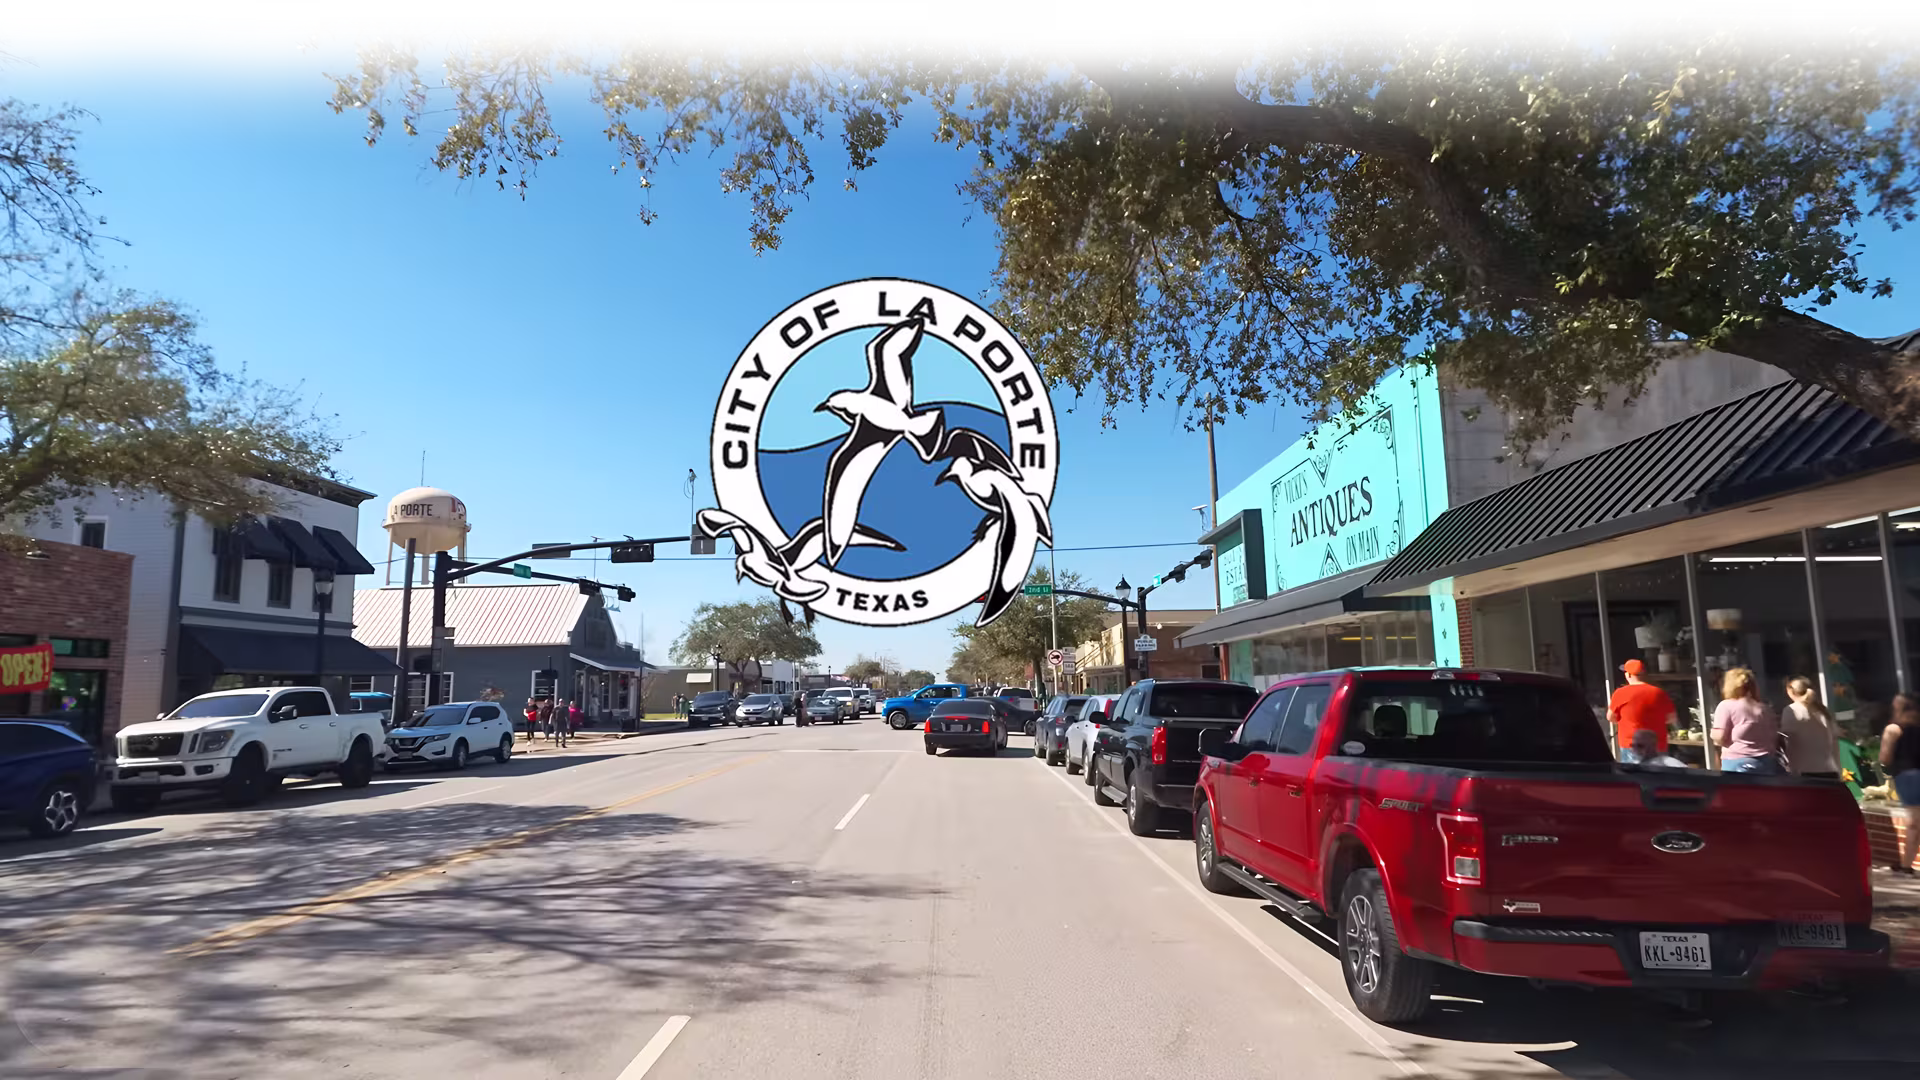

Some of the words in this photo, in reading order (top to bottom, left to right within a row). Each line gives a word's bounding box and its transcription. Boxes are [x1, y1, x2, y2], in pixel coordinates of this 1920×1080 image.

[401, 503, 433, 517] PORTE
[1290, 475, 1373, 548] ANTIQUES
[1346, 534, 1358, 566] ON
[1358, 525, 1380, 563] MAIN
[1, 651, 49, 687] OPEN!
[1379, 797, 1425, 812] SPORT
